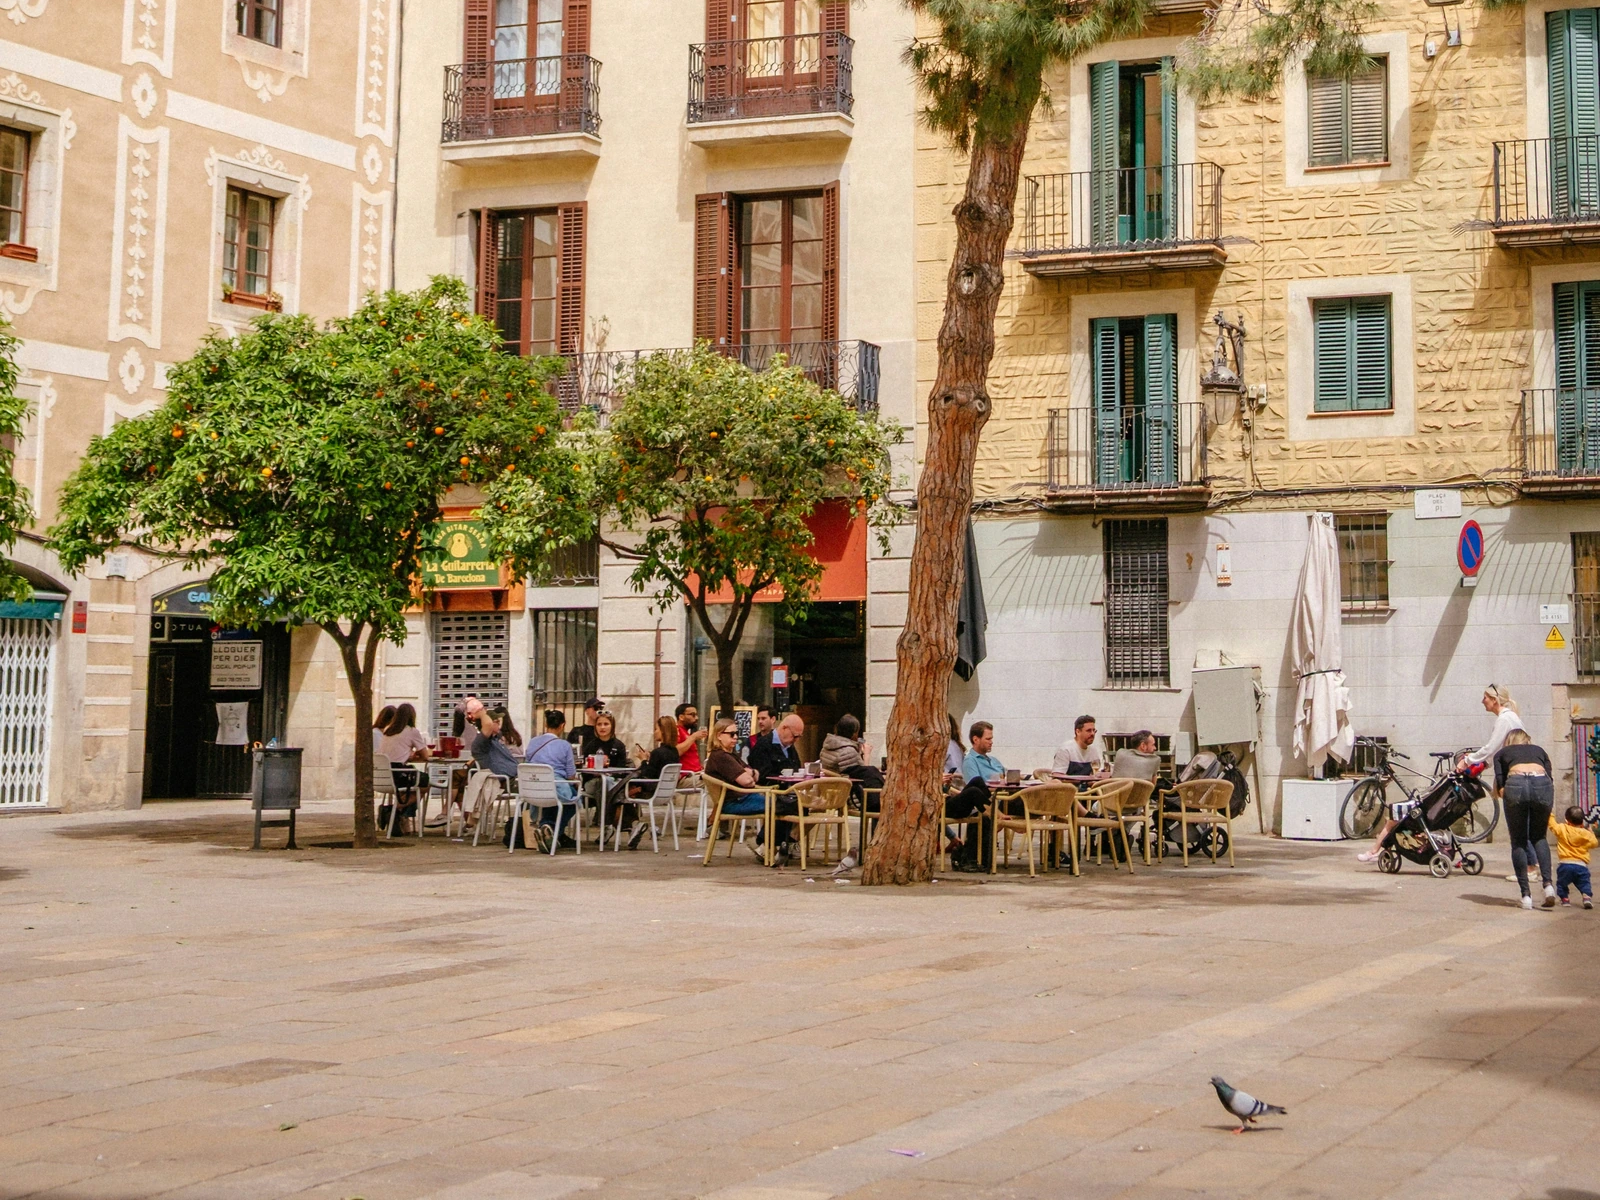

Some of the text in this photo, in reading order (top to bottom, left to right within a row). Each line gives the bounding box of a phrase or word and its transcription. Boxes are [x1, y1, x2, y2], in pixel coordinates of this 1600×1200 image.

[446, 523, 469, 533] BITAR
[425, 560, 438, 572] La
[434, 573, 486, 583] De Barcelona
